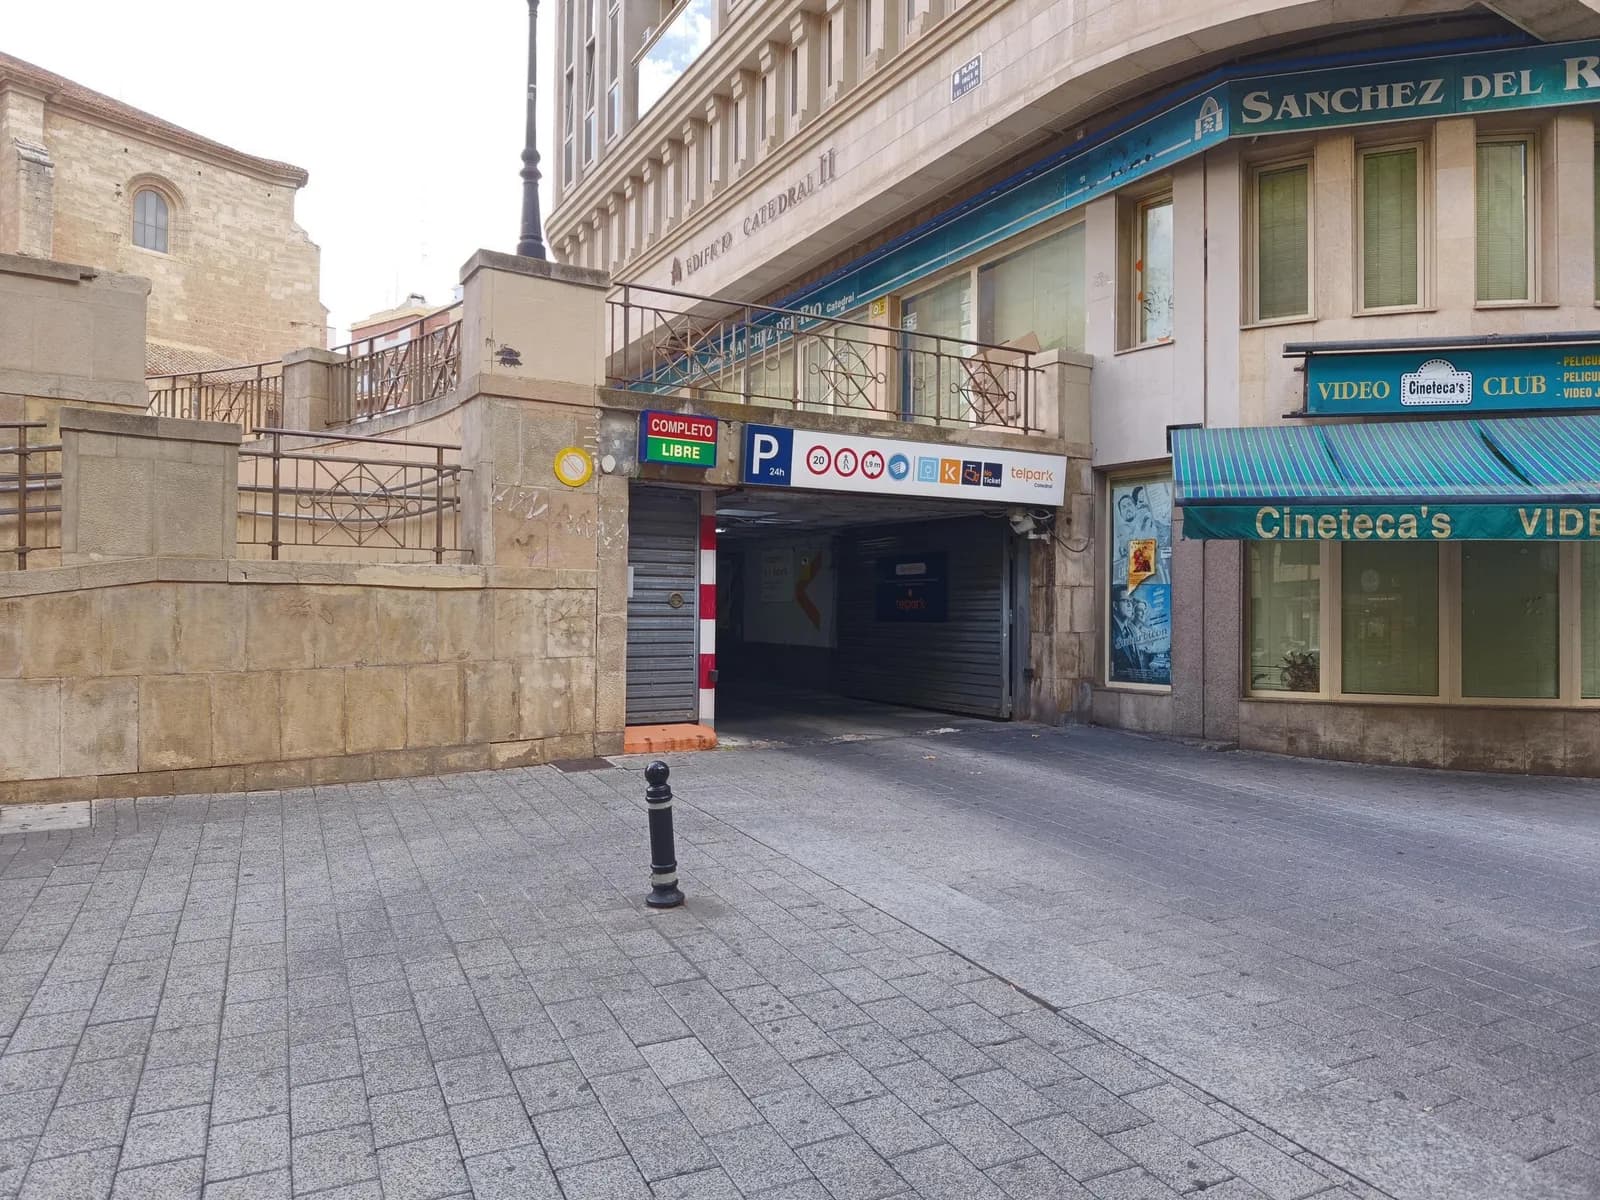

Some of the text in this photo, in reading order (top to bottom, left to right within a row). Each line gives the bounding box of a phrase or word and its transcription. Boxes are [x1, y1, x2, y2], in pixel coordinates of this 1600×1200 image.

[1241, 78, 1445, 123] SANCHEZ
[1462, 69, 1544, 101] DEL
[743, 173, 814, 236] CATEDRAL
[1563, 356, 1600, 367] PELICU
[1563, 371, 1600, 382] PELICU
[1317, 375, 1547, 400] VIDEO Cineteca's CLUB
[1563, 387, 1592, 398] VIDEO
[651, 418, 713, 437] COMPLETO
[662, 443, 700, 459] LIBRE
[752, 433, 779, 475] P
[813, 455, 825, 465] 20
[769, 467, 785, 477] 24h
[1011, 466, 1053, 482] telpark
[1255, 505, 1452, 539] Cineteca's
